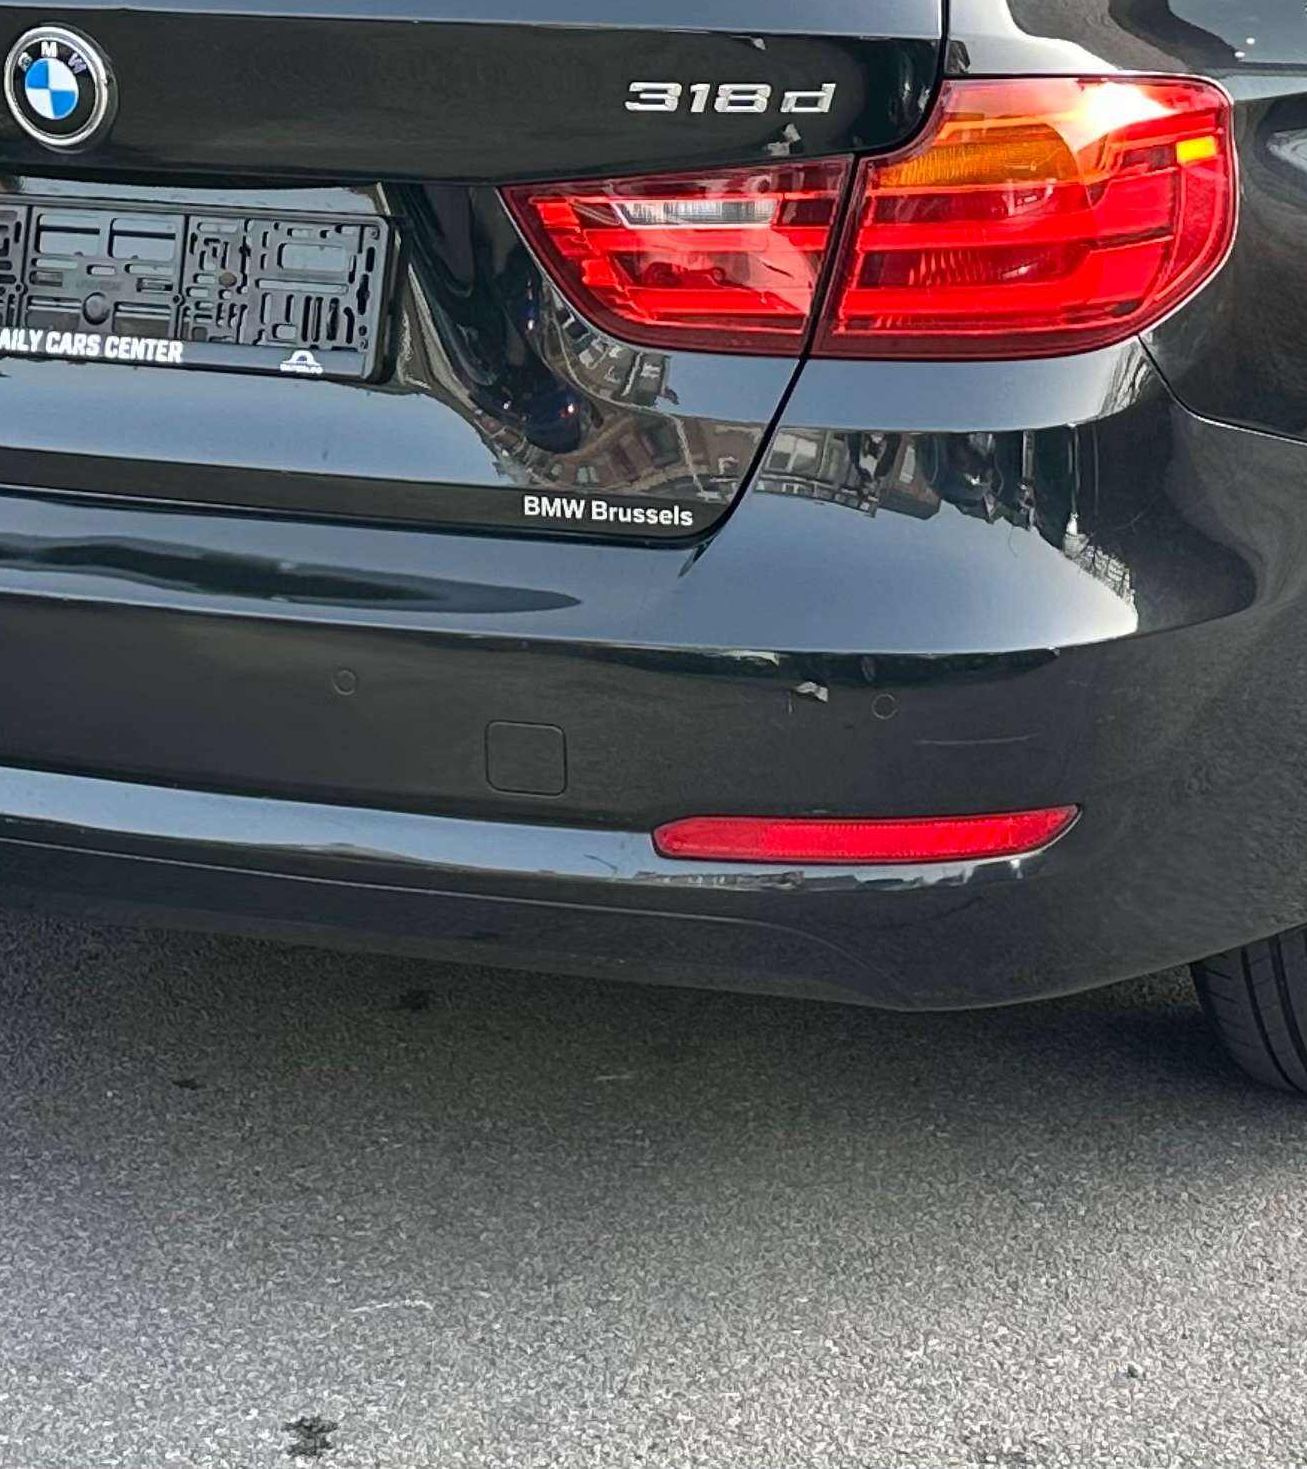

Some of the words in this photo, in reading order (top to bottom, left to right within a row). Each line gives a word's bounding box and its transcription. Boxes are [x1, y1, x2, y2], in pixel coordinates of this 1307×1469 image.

[18, 41, 87, 74] BMW
[45, 331, 101, 358] CARS
[104, 335, 183, 363] CENTER
[524, 495, 586, 519] BMW
[591, 500, 694, 527] Brussels
